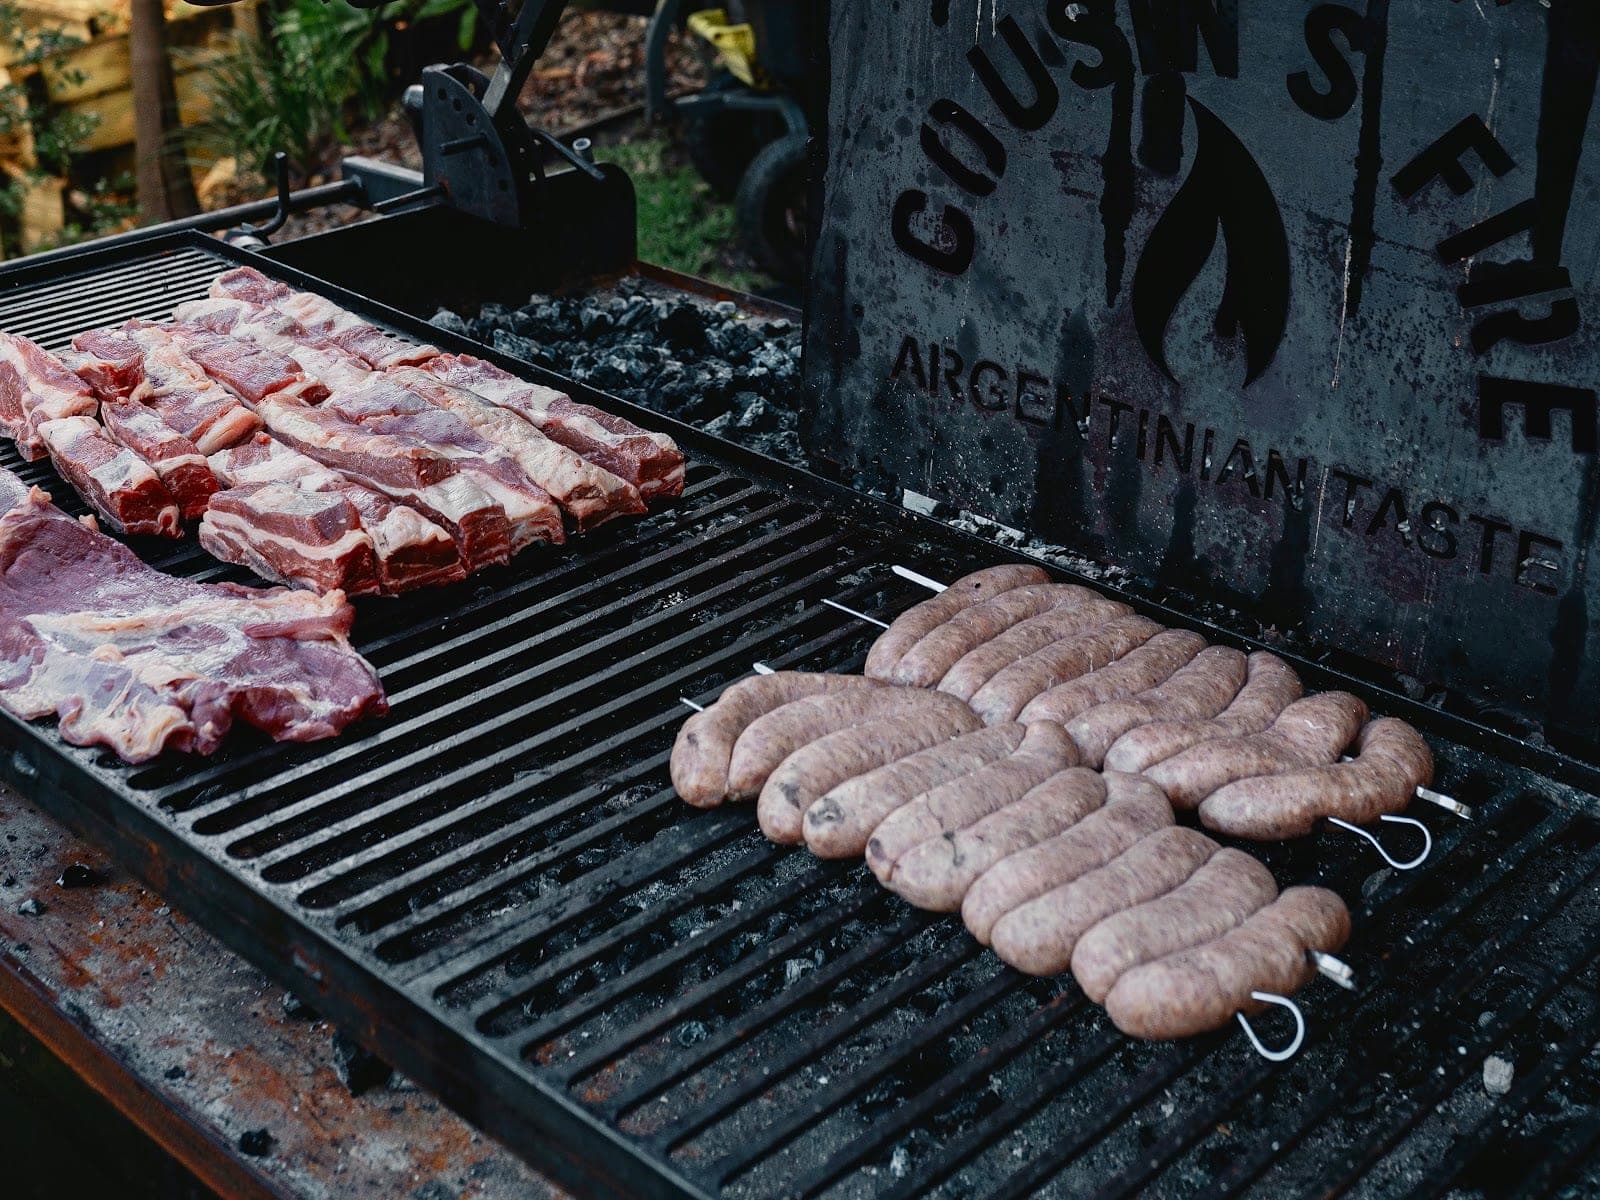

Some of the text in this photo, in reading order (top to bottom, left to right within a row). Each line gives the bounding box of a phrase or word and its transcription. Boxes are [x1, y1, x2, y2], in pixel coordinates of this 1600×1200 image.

[1389, 112, 1597, 455] FIRE
[890, 334, 1563, 596] ARGENTINIAN TASTE
